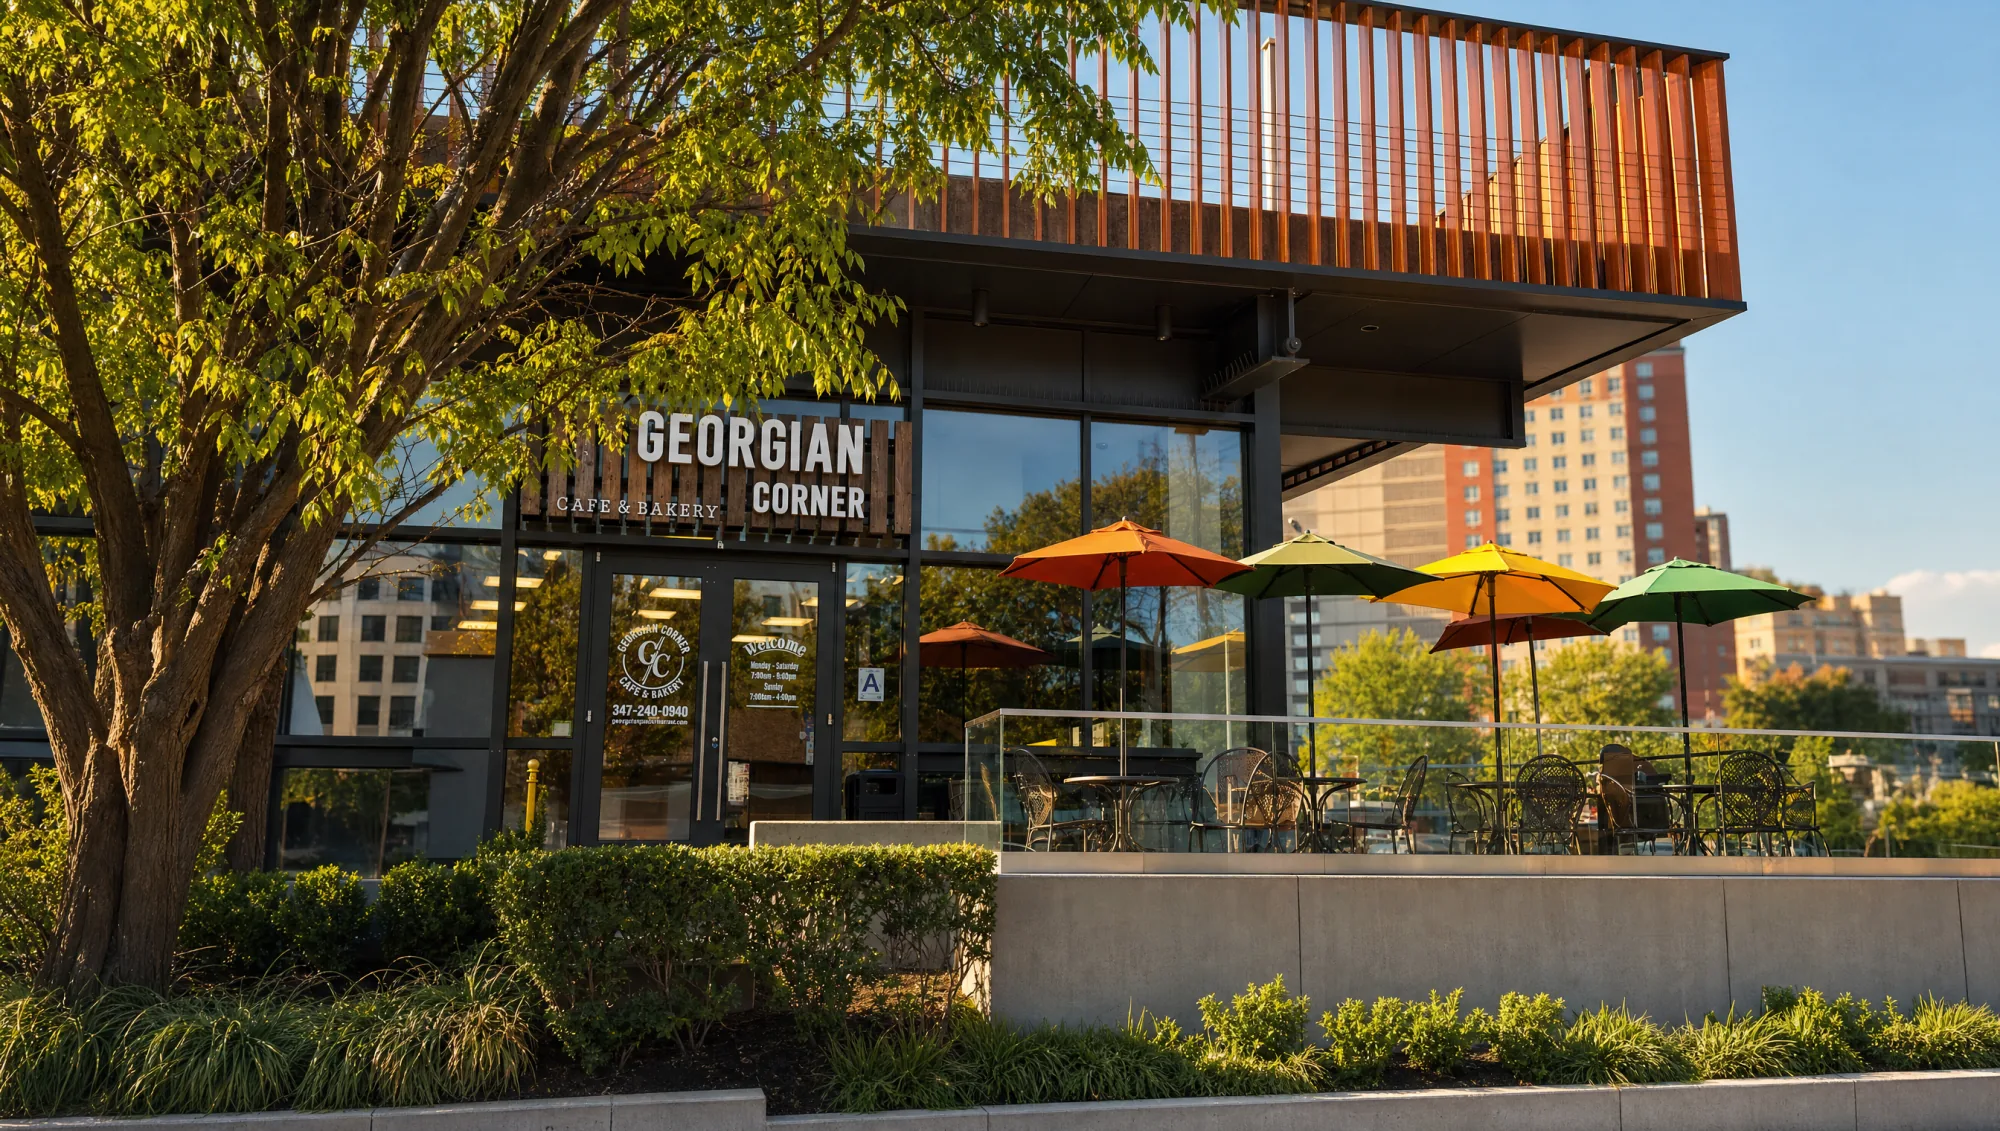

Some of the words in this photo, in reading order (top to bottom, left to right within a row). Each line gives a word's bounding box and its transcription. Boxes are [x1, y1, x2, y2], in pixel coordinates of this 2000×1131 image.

[637, 410, 864, 475] GEORGIAN
[556, 496, 611, 514] CAFE
[618, 499, 631, 515] &
[637, 501, 719, 519] BAKERY
[752, 481, 865, 519] CORNER
[617, 623, 658, 653] GEORGIAN
[660, 624, 691, 655] CORNER
[742, 638, 807, 657] Welcome
[750, 661, 771, 671] Monday
[776, 662, 799, 671] Saturday
[619, 676, 642, 696] CAFE
[641, 689, 650, 699] &
[651, 678, 685, 699] BAKERY
[862, 673, 880, 692] A
[612, 704, 689, 717] 347-240-0940
